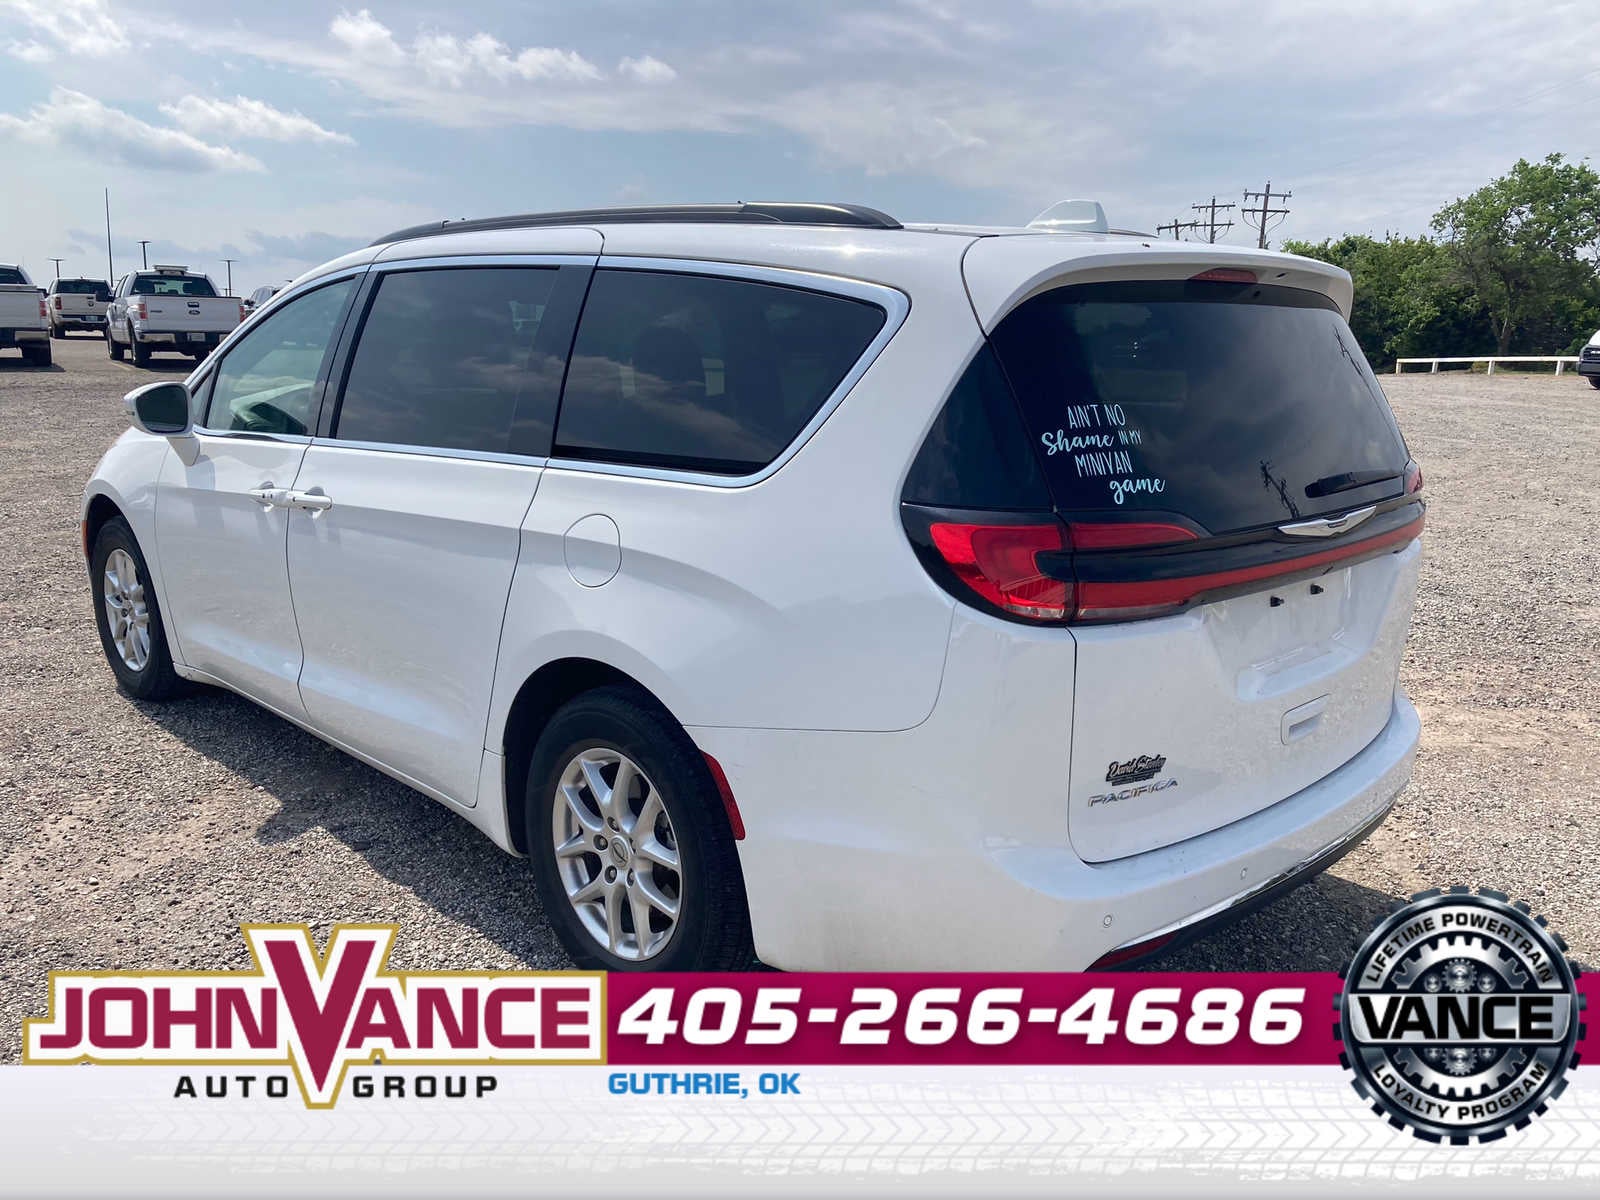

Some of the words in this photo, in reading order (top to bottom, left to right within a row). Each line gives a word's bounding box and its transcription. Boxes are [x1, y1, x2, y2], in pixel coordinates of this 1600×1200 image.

[1067, 404, 1101, 430] AIN'T
[1104, 403, 1126, 427] NO
[1041, 429, 1114, 456] Shame
[1118, 430, 1129, 446] IN
[1129, 429, 1142, 445] MY
[1074, 450, 1133, 478] MINIVAN
[1109, 478, 1166, 505] game
[1088, 778, 1178, 807] PACIFICA
